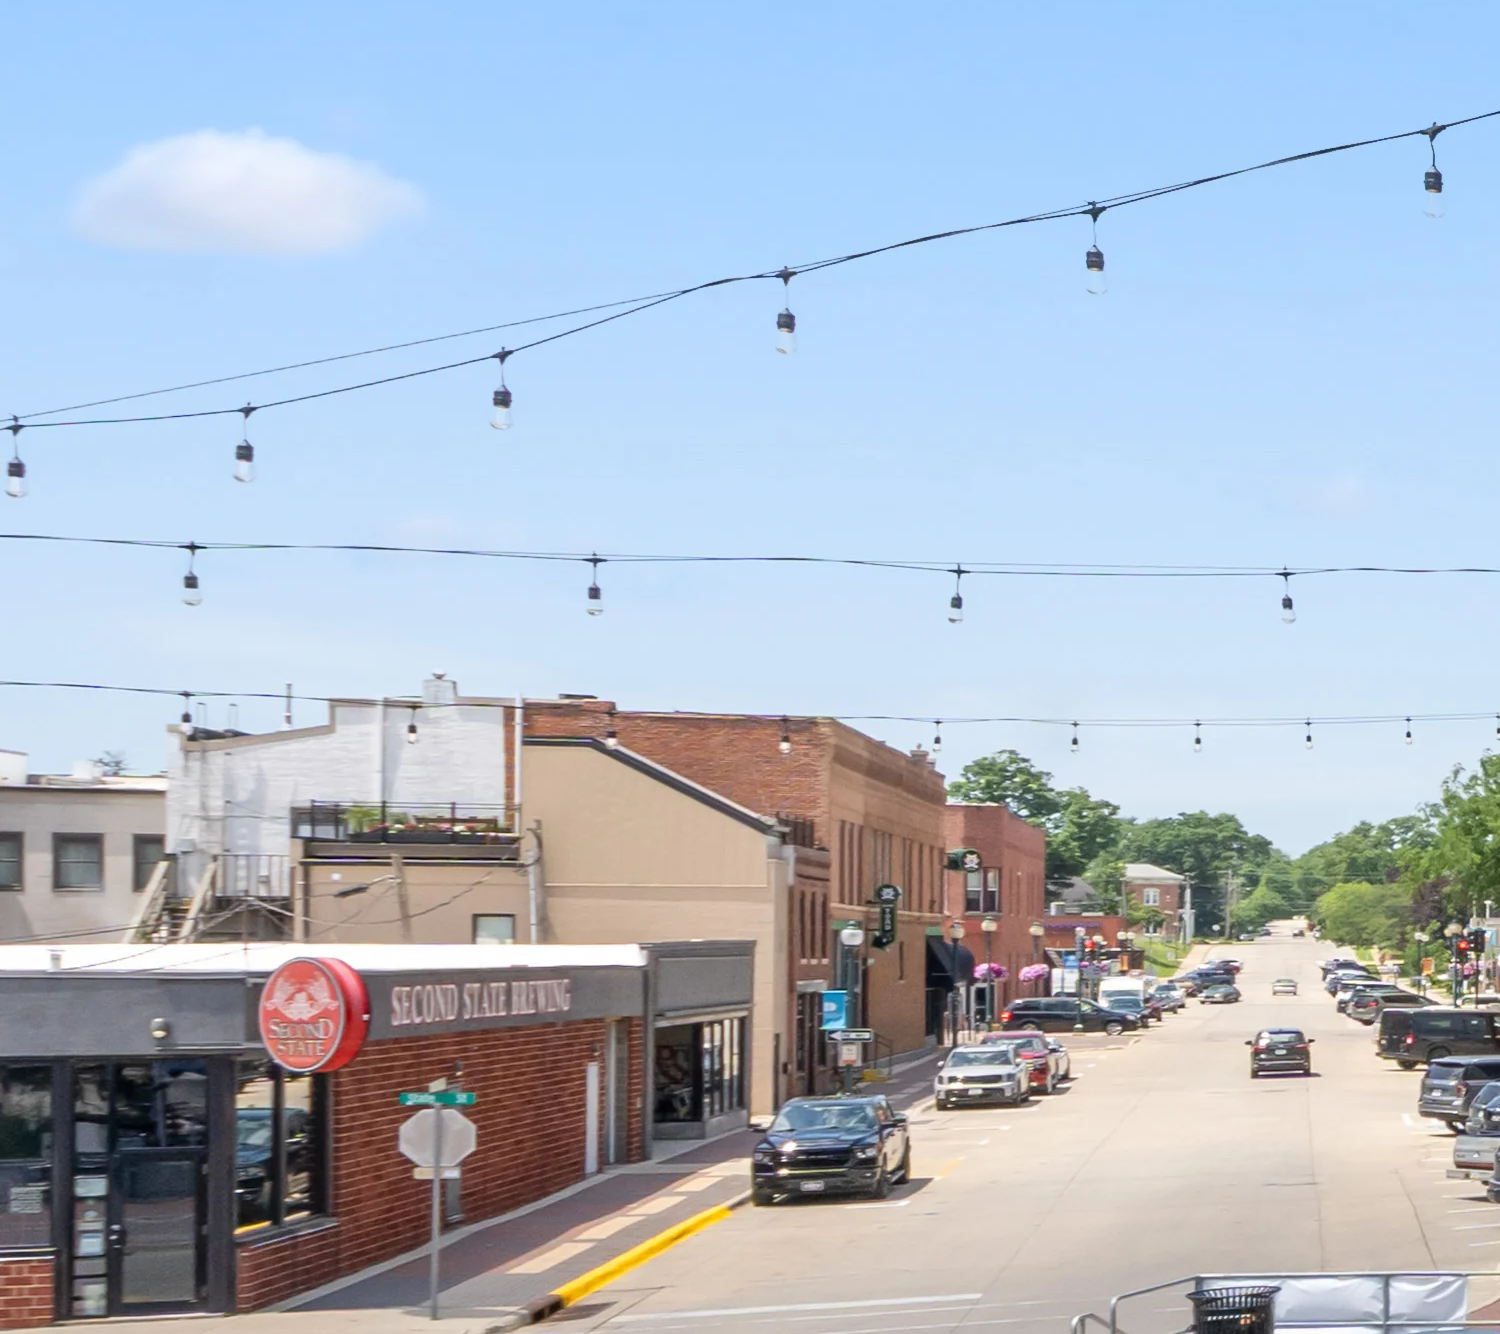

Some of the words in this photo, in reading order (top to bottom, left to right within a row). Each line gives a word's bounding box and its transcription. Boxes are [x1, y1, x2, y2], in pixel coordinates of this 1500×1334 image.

[391, 984, 459, 1026] SECOND
[463, 981, 507, 1020] STATE
[511, 978, 571, 1015] BREWING
[268, 1017, 334, 1039] SECOND
[277, 1039, 326, 1057] STATE
